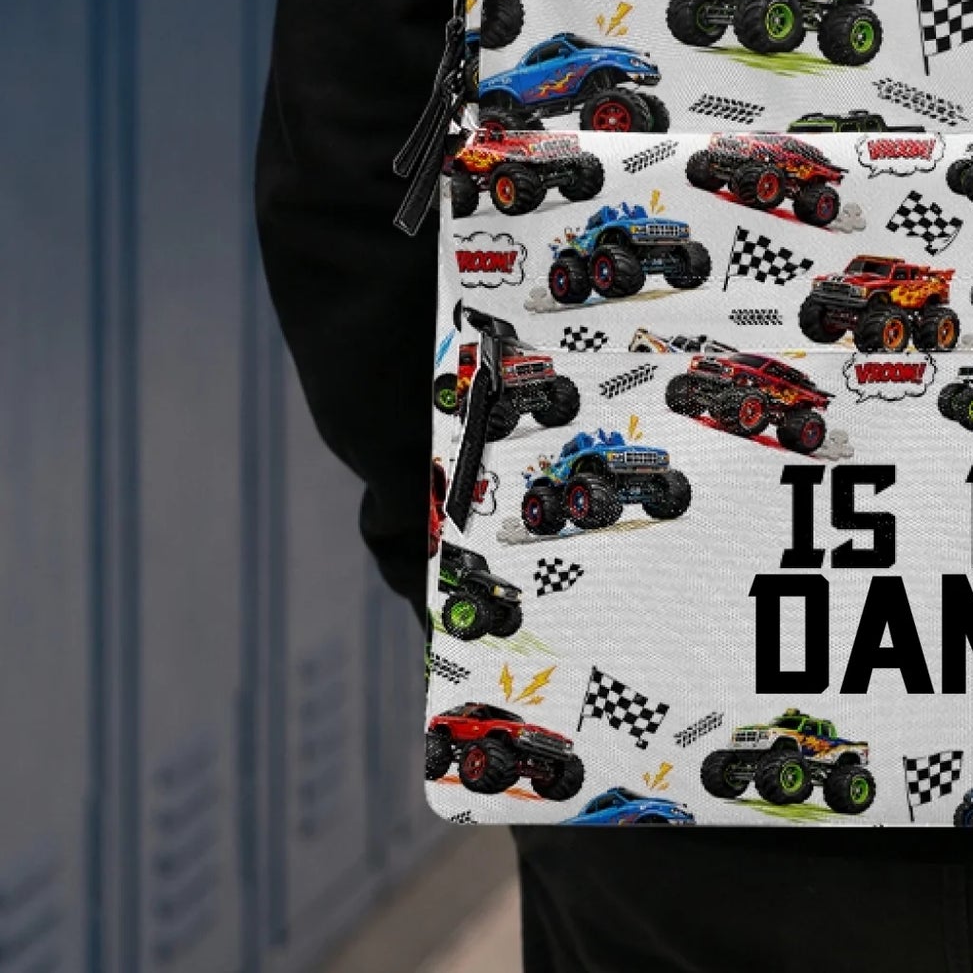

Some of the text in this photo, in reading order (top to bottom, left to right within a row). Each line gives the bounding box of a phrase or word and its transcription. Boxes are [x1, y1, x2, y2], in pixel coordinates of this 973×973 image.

[455, 250, 518, 274] ROOM!
[854, 361, 927, 385] VROOM!
[779, 464, 896, 568] IS
